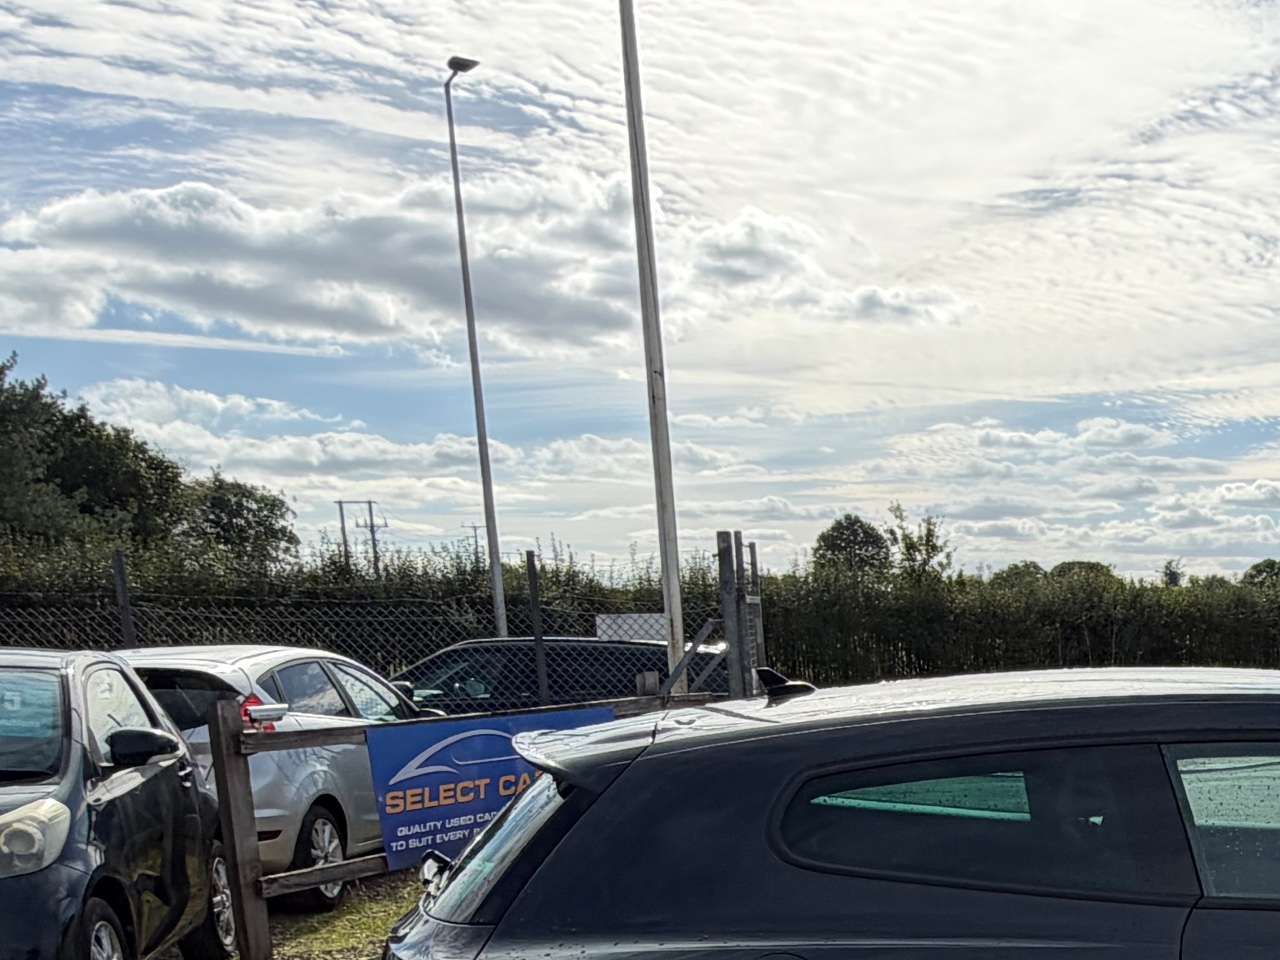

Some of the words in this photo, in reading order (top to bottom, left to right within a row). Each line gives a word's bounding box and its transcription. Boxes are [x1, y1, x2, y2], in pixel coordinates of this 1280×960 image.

[385, 778, 491, 815] SELECT
[498, 769, 543, 797] CA
[397, 821, 443, 837] QUALITY
[446, 816, 475, 828] USED
[390, 841, 406, 851] TO
[408, 836, 433, 849] SUIT
[436, 830, 470, 844] EVERY
